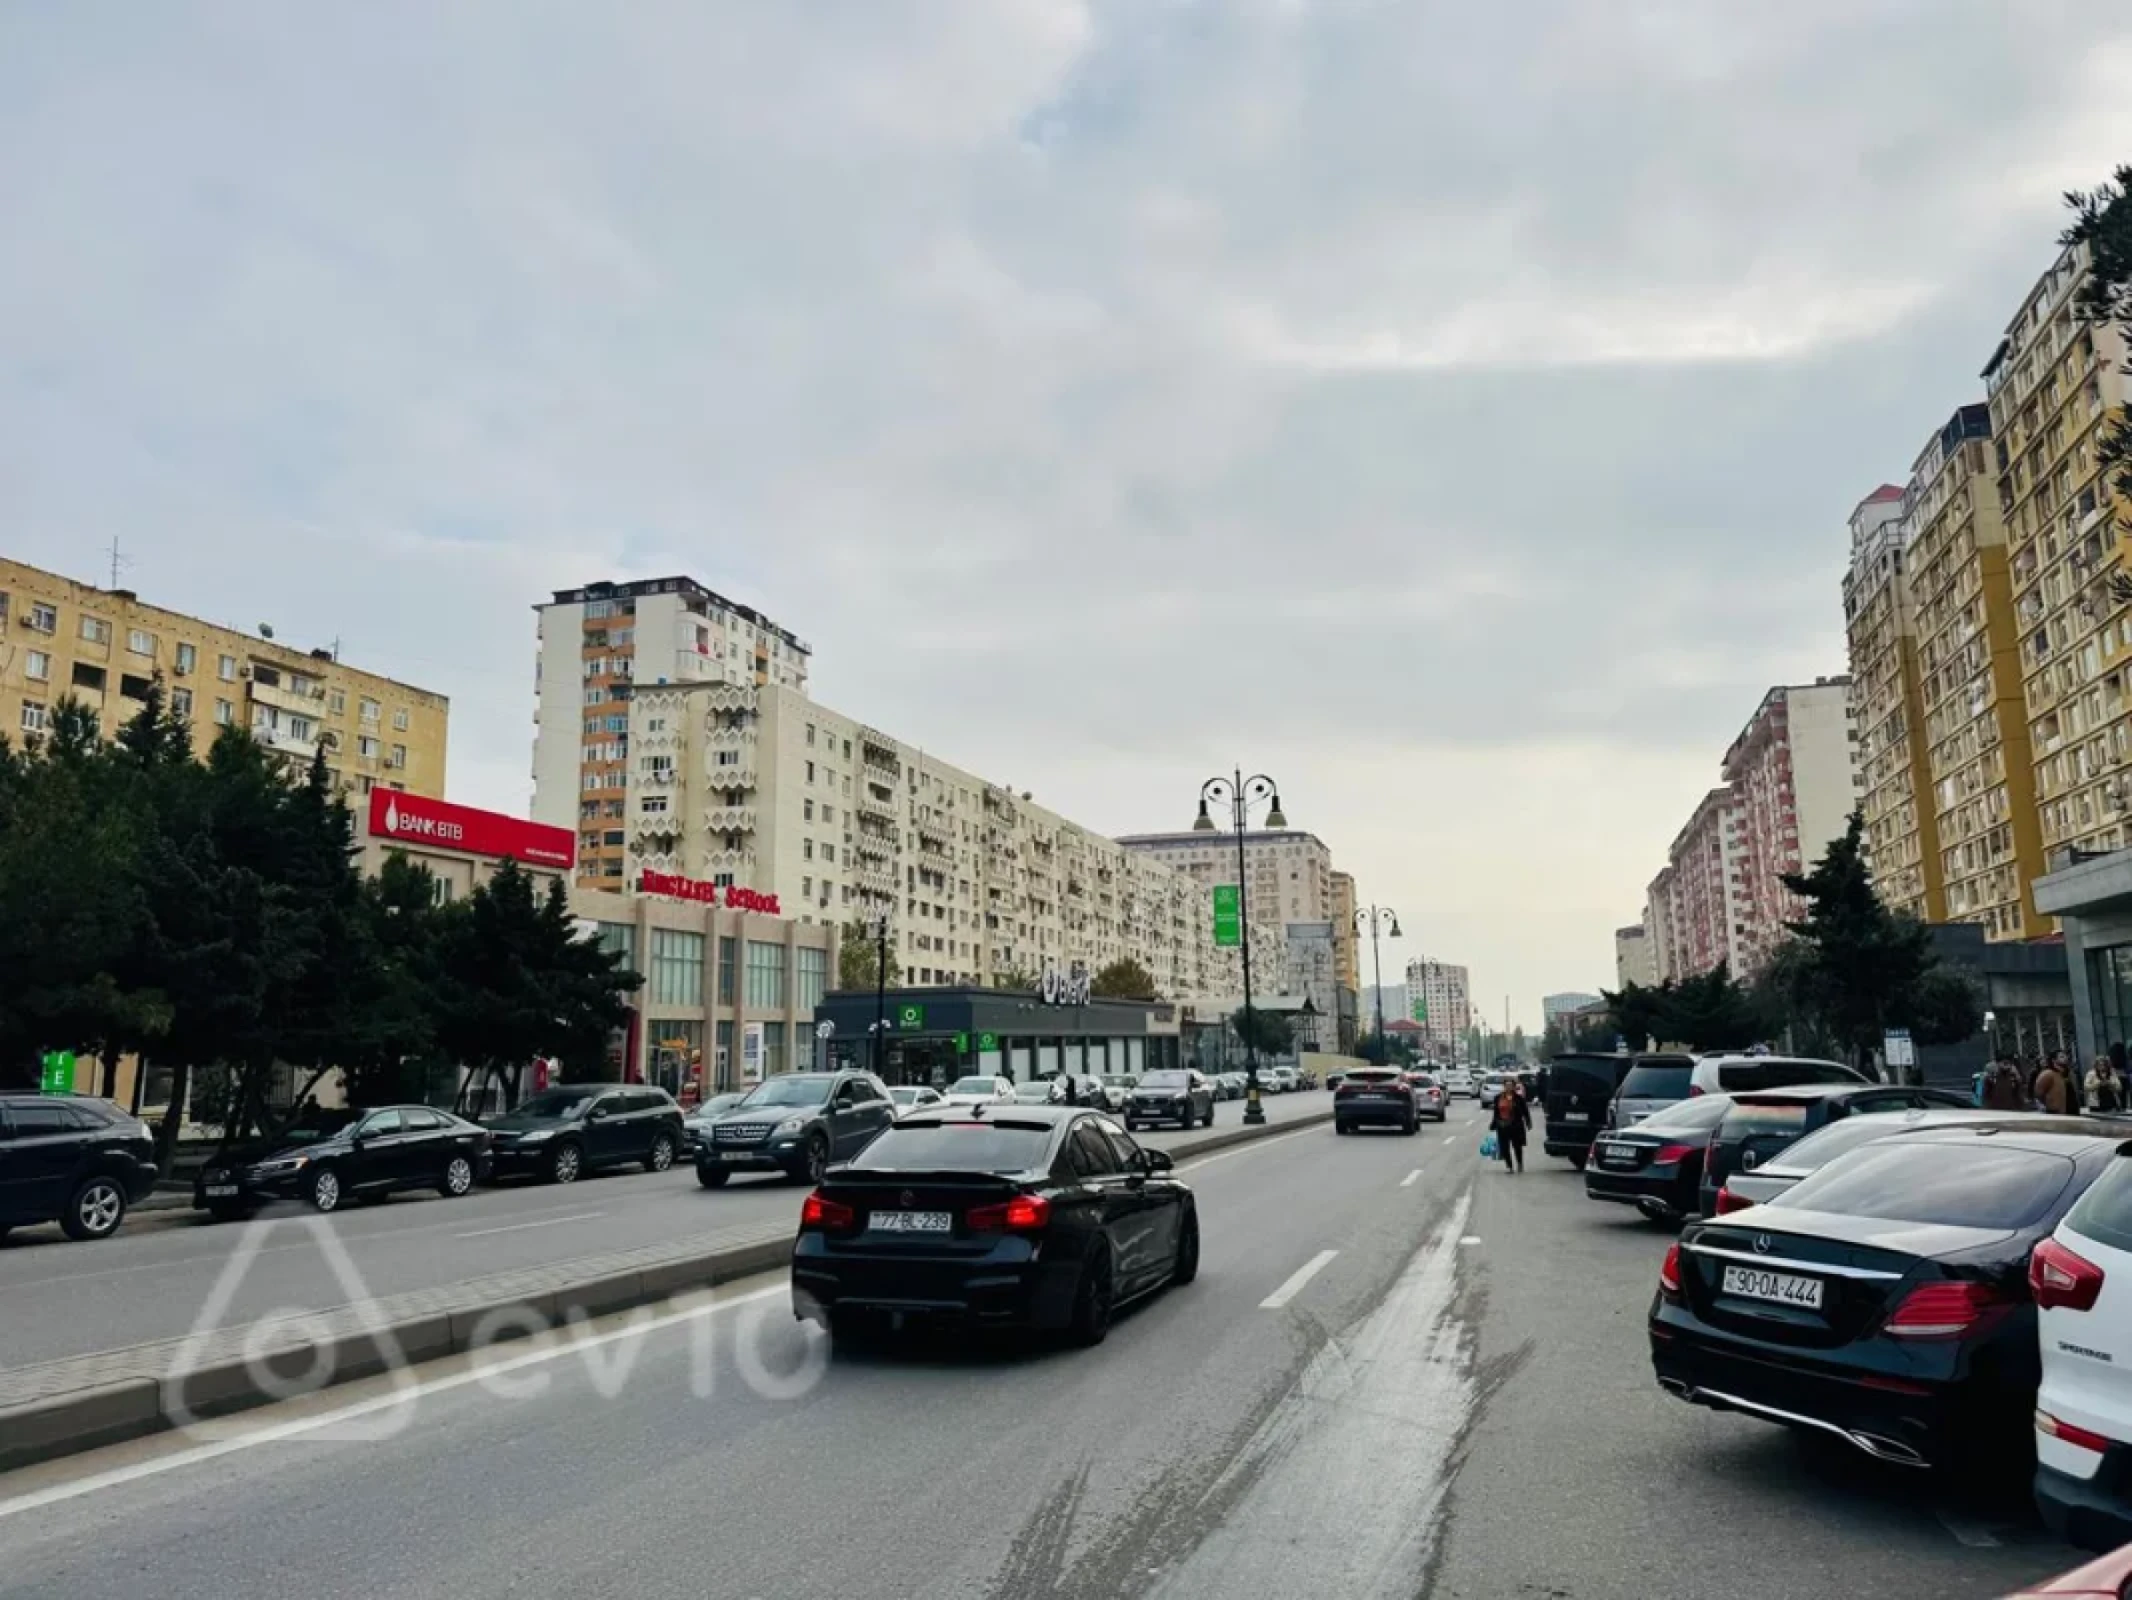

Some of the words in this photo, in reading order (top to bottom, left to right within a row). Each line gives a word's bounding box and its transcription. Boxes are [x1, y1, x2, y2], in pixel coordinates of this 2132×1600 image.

[399, 813, 436, 835] BANK
[437, 821, 464, 841] BTB
[1738, 1270, 1818, 1304] 90-OA-444
